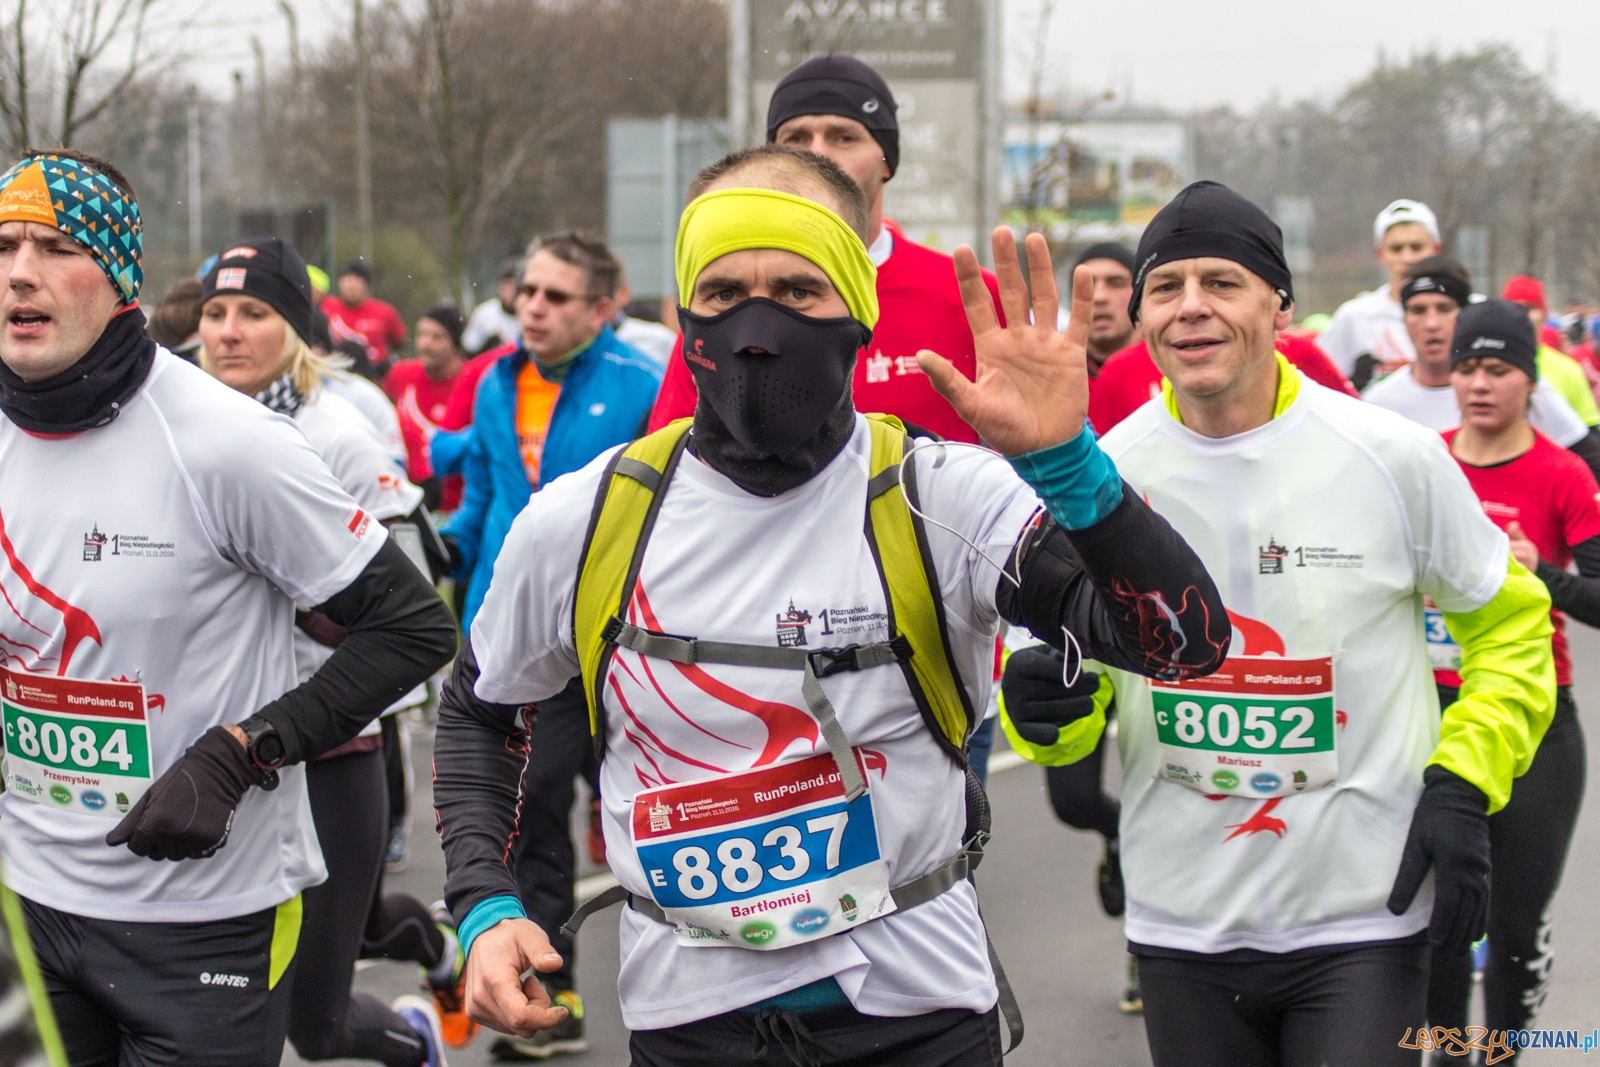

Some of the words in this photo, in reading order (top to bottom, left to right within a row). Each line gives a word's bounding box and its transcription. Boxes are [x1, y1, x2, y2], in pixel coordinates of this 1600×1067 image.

[686, 351, 717, 372] CARRERA
[111, 534, 120, 555] 1
[1294, 546, 1307, 567] 1
[830, 605, 868, 616] Poznański
[831, 616, 848, 624] Bieg
[848, 612, 888, 623] Niepodleg
[818, 608, 834, 635] 1
[1244, 674, 1322, 685] RunPoland.org
[67, 694, 134, 711] RunPoland.org
[1156, 711, 1169, 725] C
[1174, 701, 1316, 749] 8052
[6, 722, 14, 737] C
[16, 715, 133, 771] 8084
[1217, 755, 1262, 767] Mariusz
[43, 769, 100, 786] Przemysław
[754, 771, 842, 803] RunPoland.or
[676, 802, 689, 821] 1
[650, 869, 668, 887] E
[672, 810, 849, 900] 8837
[731, 889, 811, 918] Bartłomiej
[211, 973, 249, 988] HI-TEC
